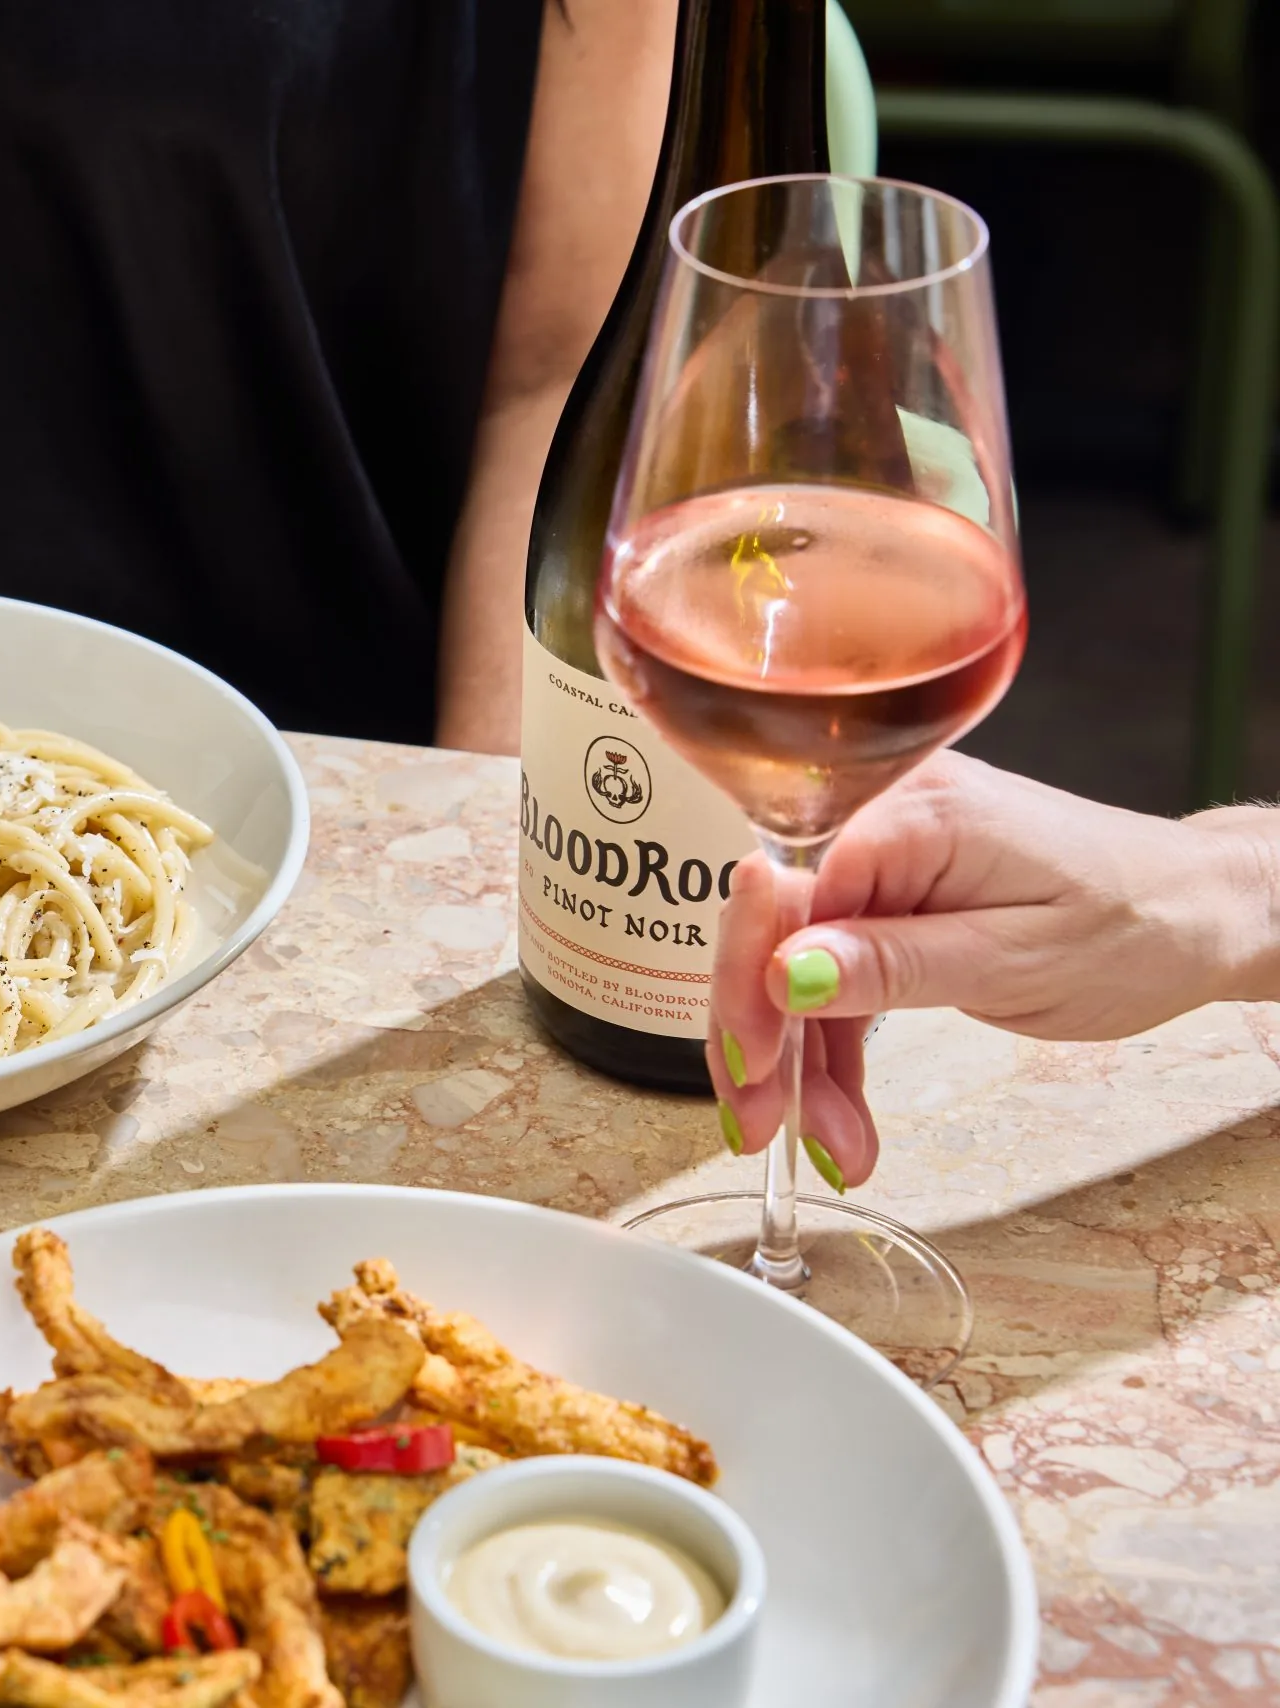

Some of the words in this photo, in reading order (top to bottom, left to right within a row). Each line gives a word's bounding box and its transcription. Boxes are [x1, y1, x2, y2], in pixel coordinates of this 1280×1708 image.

[548, 673, 603, 708] COASTAL
[543, 874, 613, 928] PINOT
[624, 913, 708, 947] NOIR
[547, 950, 598, 985] BOTTLED
[603, 979, 620, 992] BY
[547, 964, 597, 1001] SONOMA,
[601, 994, 693, 1021] CALIFORNIA
